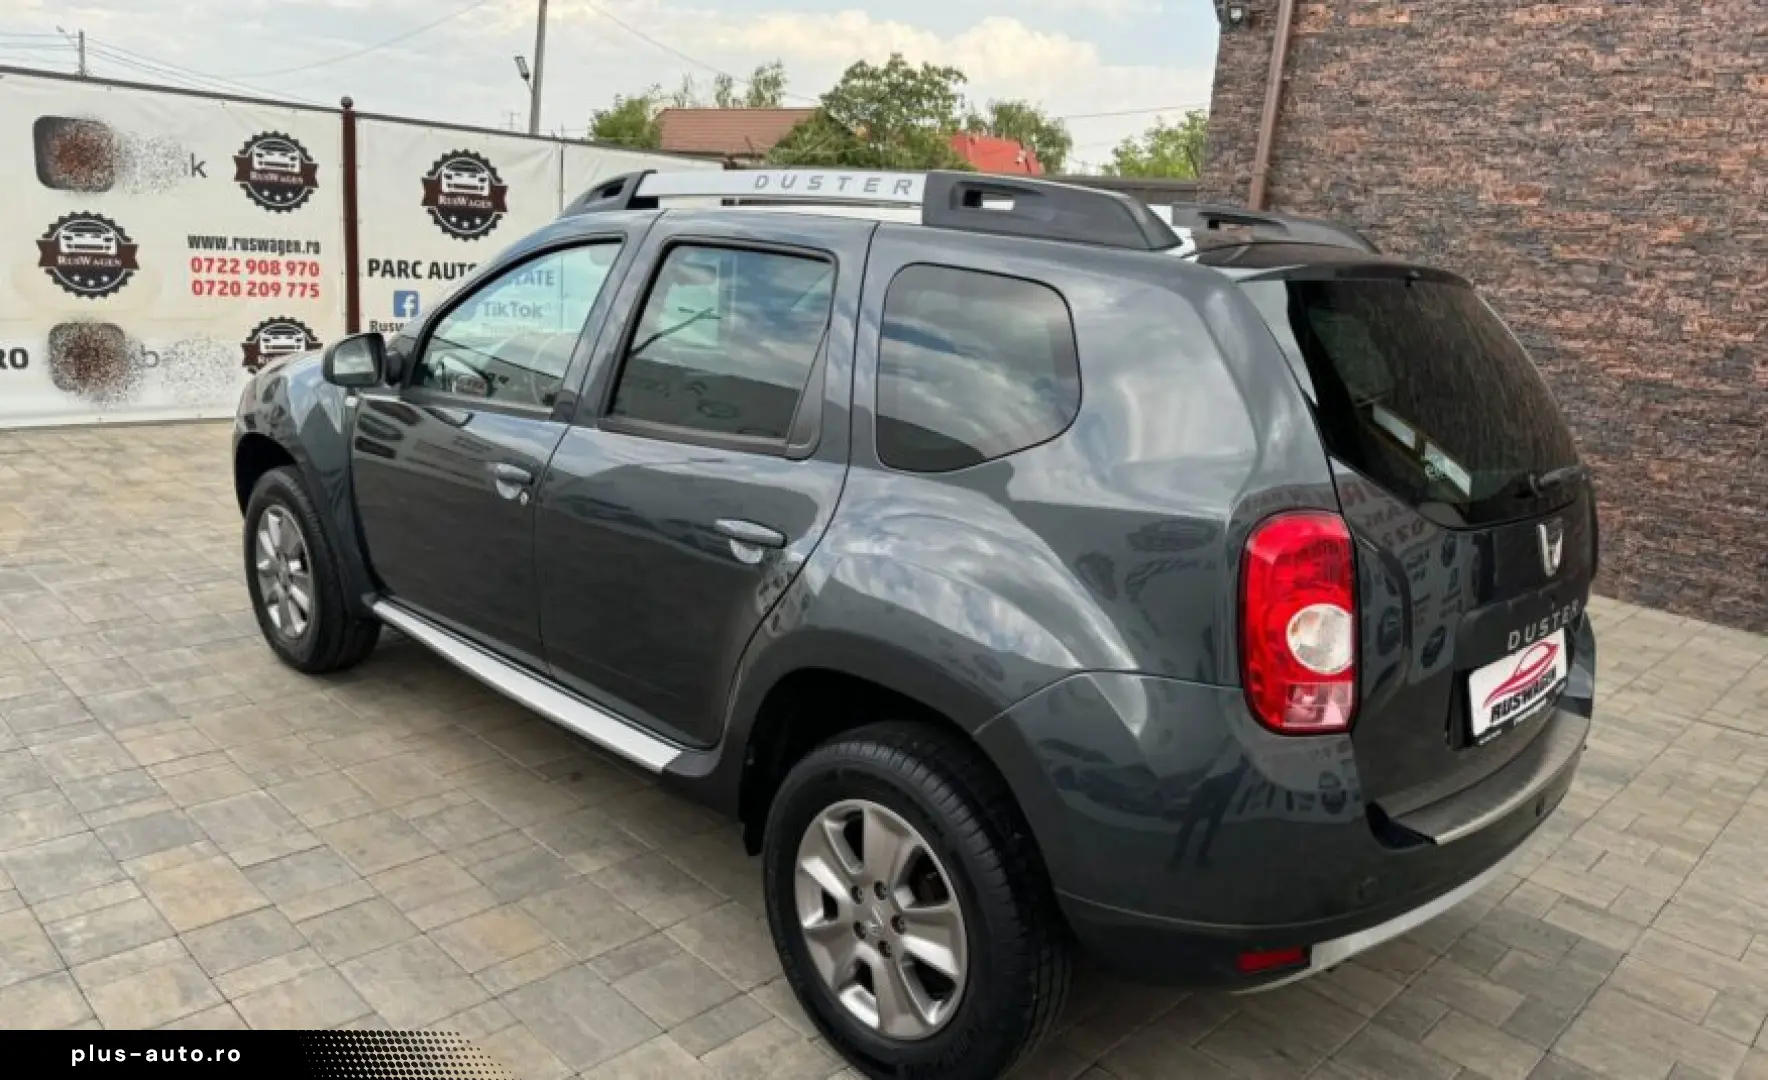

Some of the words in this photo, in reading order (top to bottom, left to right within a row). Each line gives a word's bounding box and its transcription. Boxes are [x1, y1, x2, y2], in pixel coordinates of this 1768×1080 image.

[754, 174, 913, 195] DUSTER
[187, 234, 320, 256] www.ruswagen.ro
[191, 257, 241, 275] 0722
[245, 259, 281, 276] 908
[285, 261, 320, 277] 970
[367, 258, 422, 279] PARC
[191, 280, 242, 296] 0720
[246, 281, 281, 297] 209
[286, 282, 320, 298] 775
[483, 301, 544, 319] TikTok
[1507, 600, 1579, 650] DUSTER
